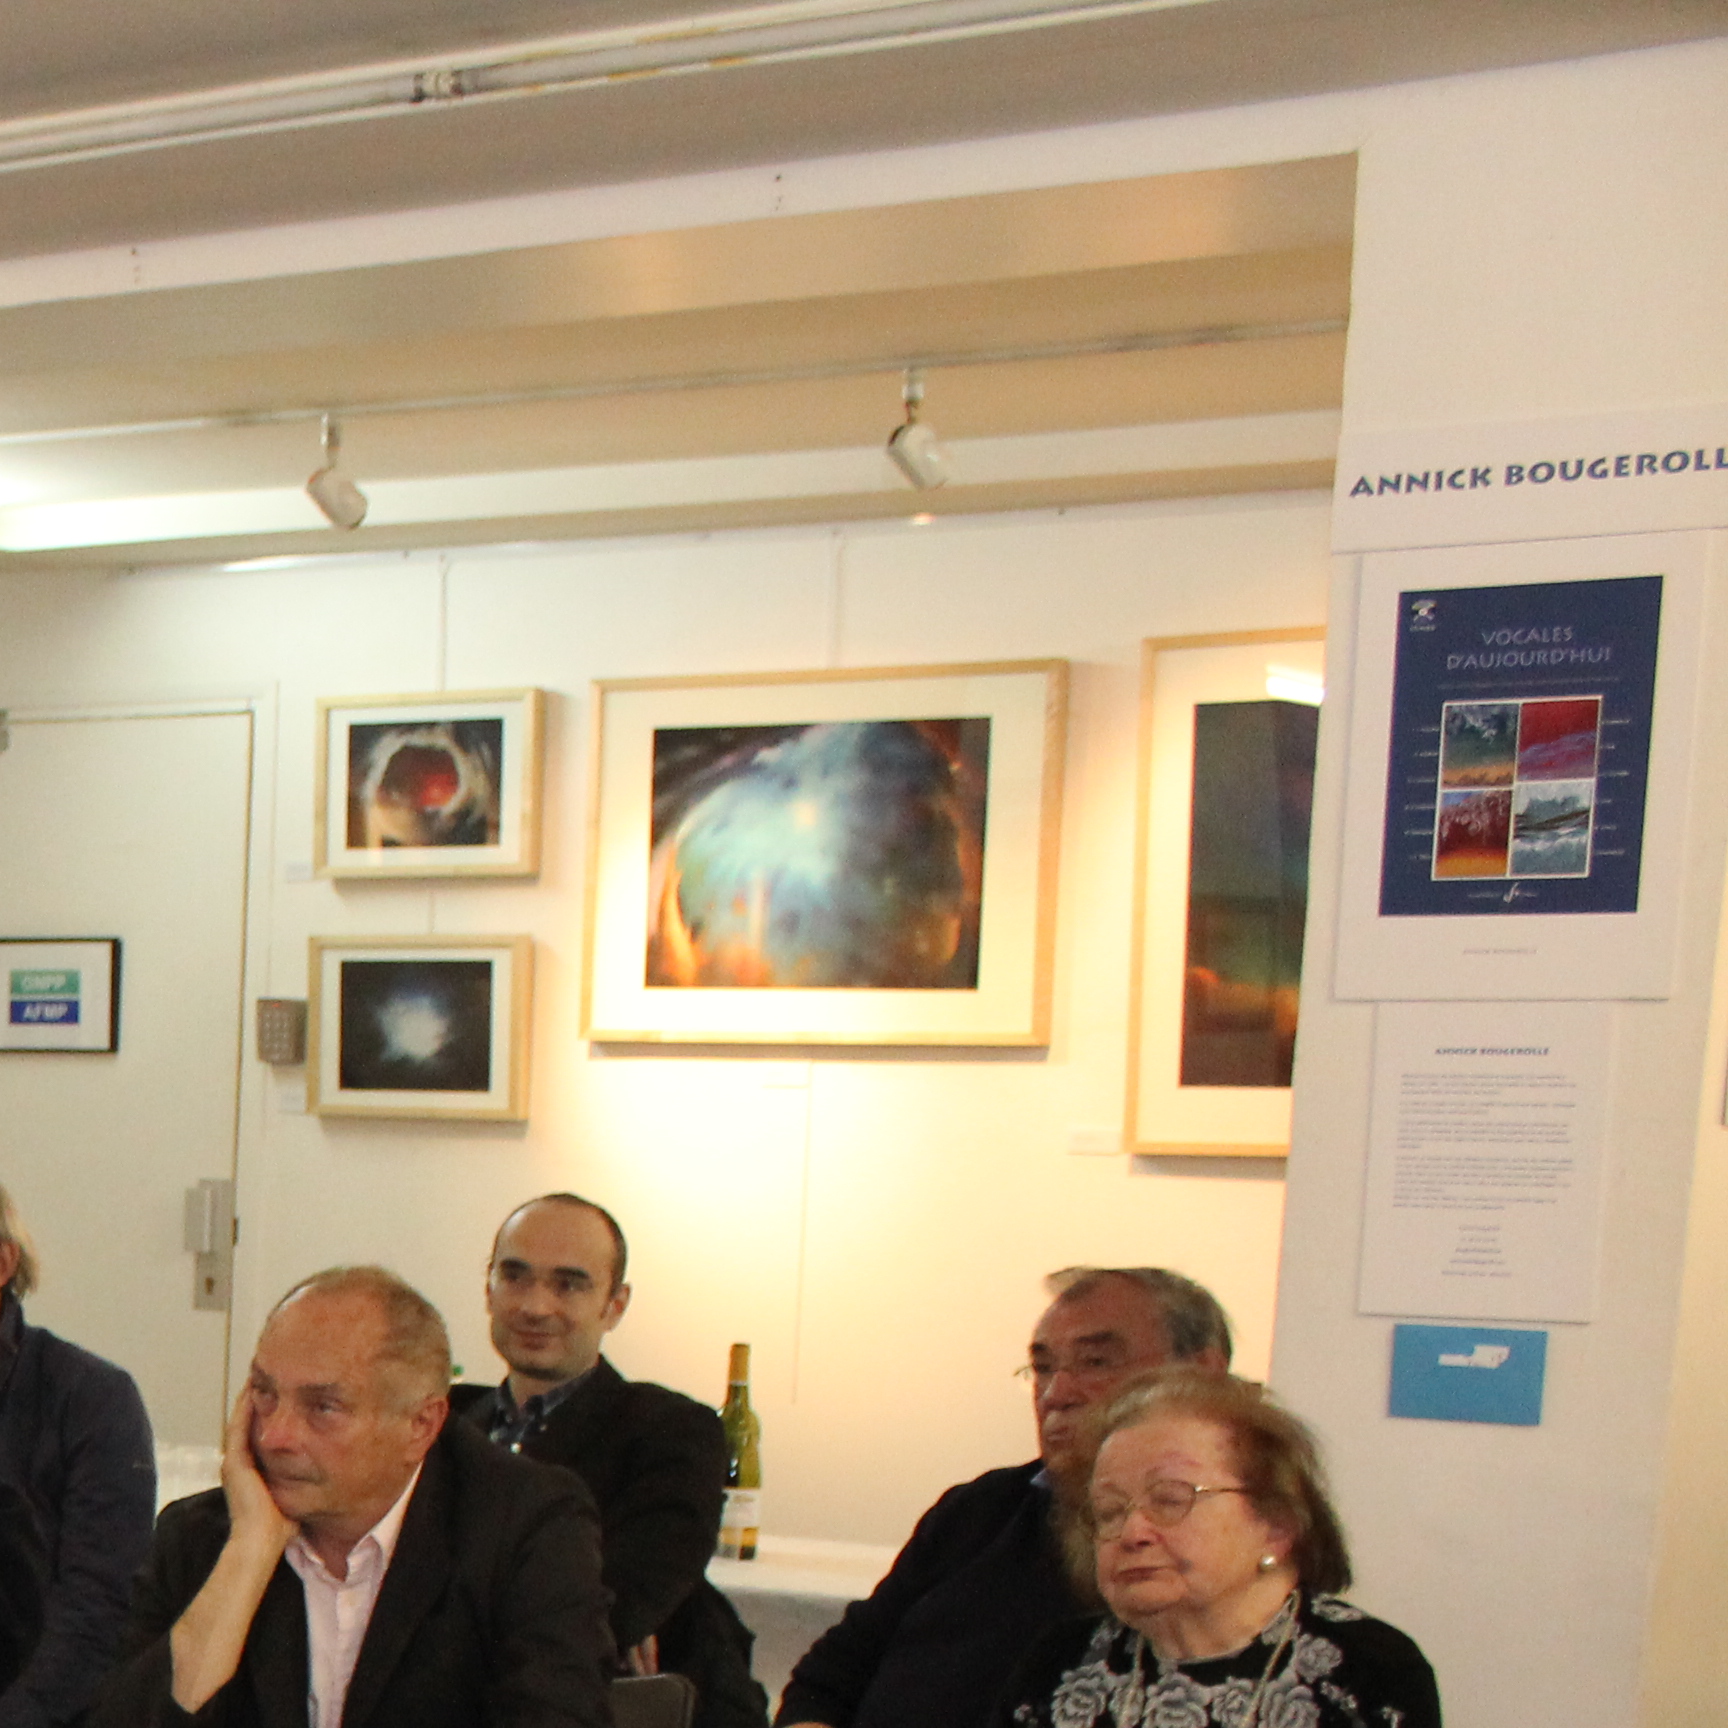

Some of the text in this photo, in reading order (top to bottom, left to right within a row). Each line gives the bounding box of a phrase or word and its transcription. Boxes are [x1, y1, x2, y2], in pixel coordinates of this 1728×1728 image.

[1349, 446, 1728, 497] ANNICK BOUGEROLL
[1482, 626, 1573, 647] VOCALES
[1447, 647, 1611, 671] D'AUJOURD'HUI
